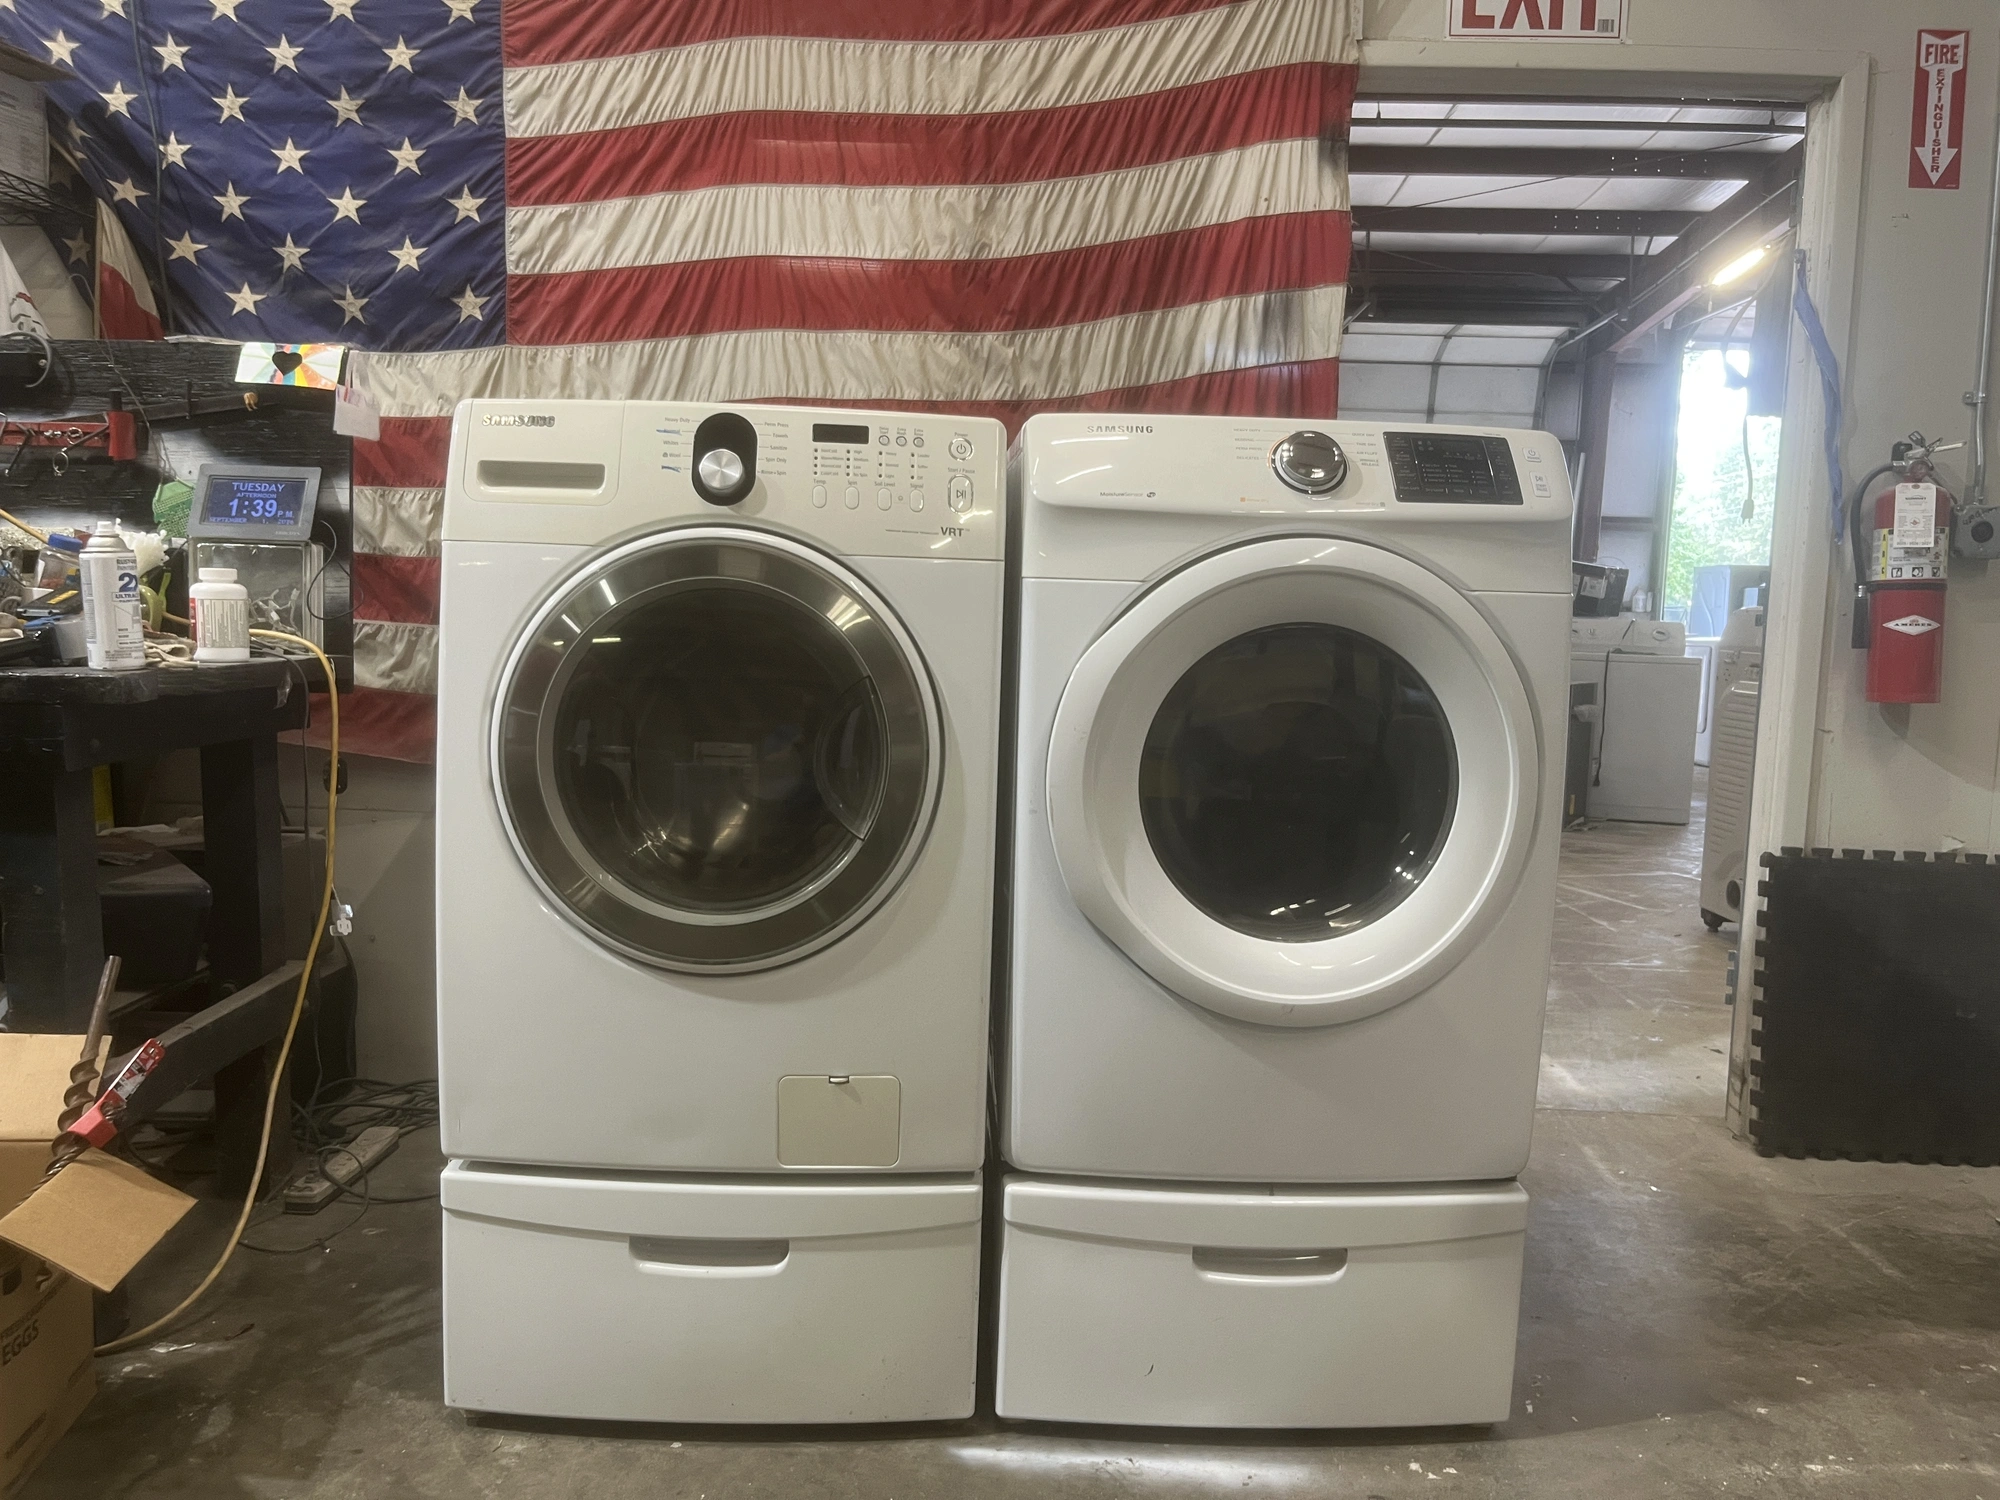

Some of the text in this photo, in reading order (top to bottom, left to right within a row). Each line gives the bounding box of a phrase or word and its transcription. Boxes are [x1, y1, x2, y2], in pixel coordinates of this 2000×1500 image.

[1924, 44, 1959, 65] FIRE
[1930, 68, 1945, 173] EXTINGUISHER
[482, 413, 556, 428] SAMSUNG
[1087, 425, 1153, 434] SAMSUNG
[232, 482, 285, 492] TUESDAY
[229, 499, 278, 518] 1:39
[2, 1318, 39, 1366] EGGS
